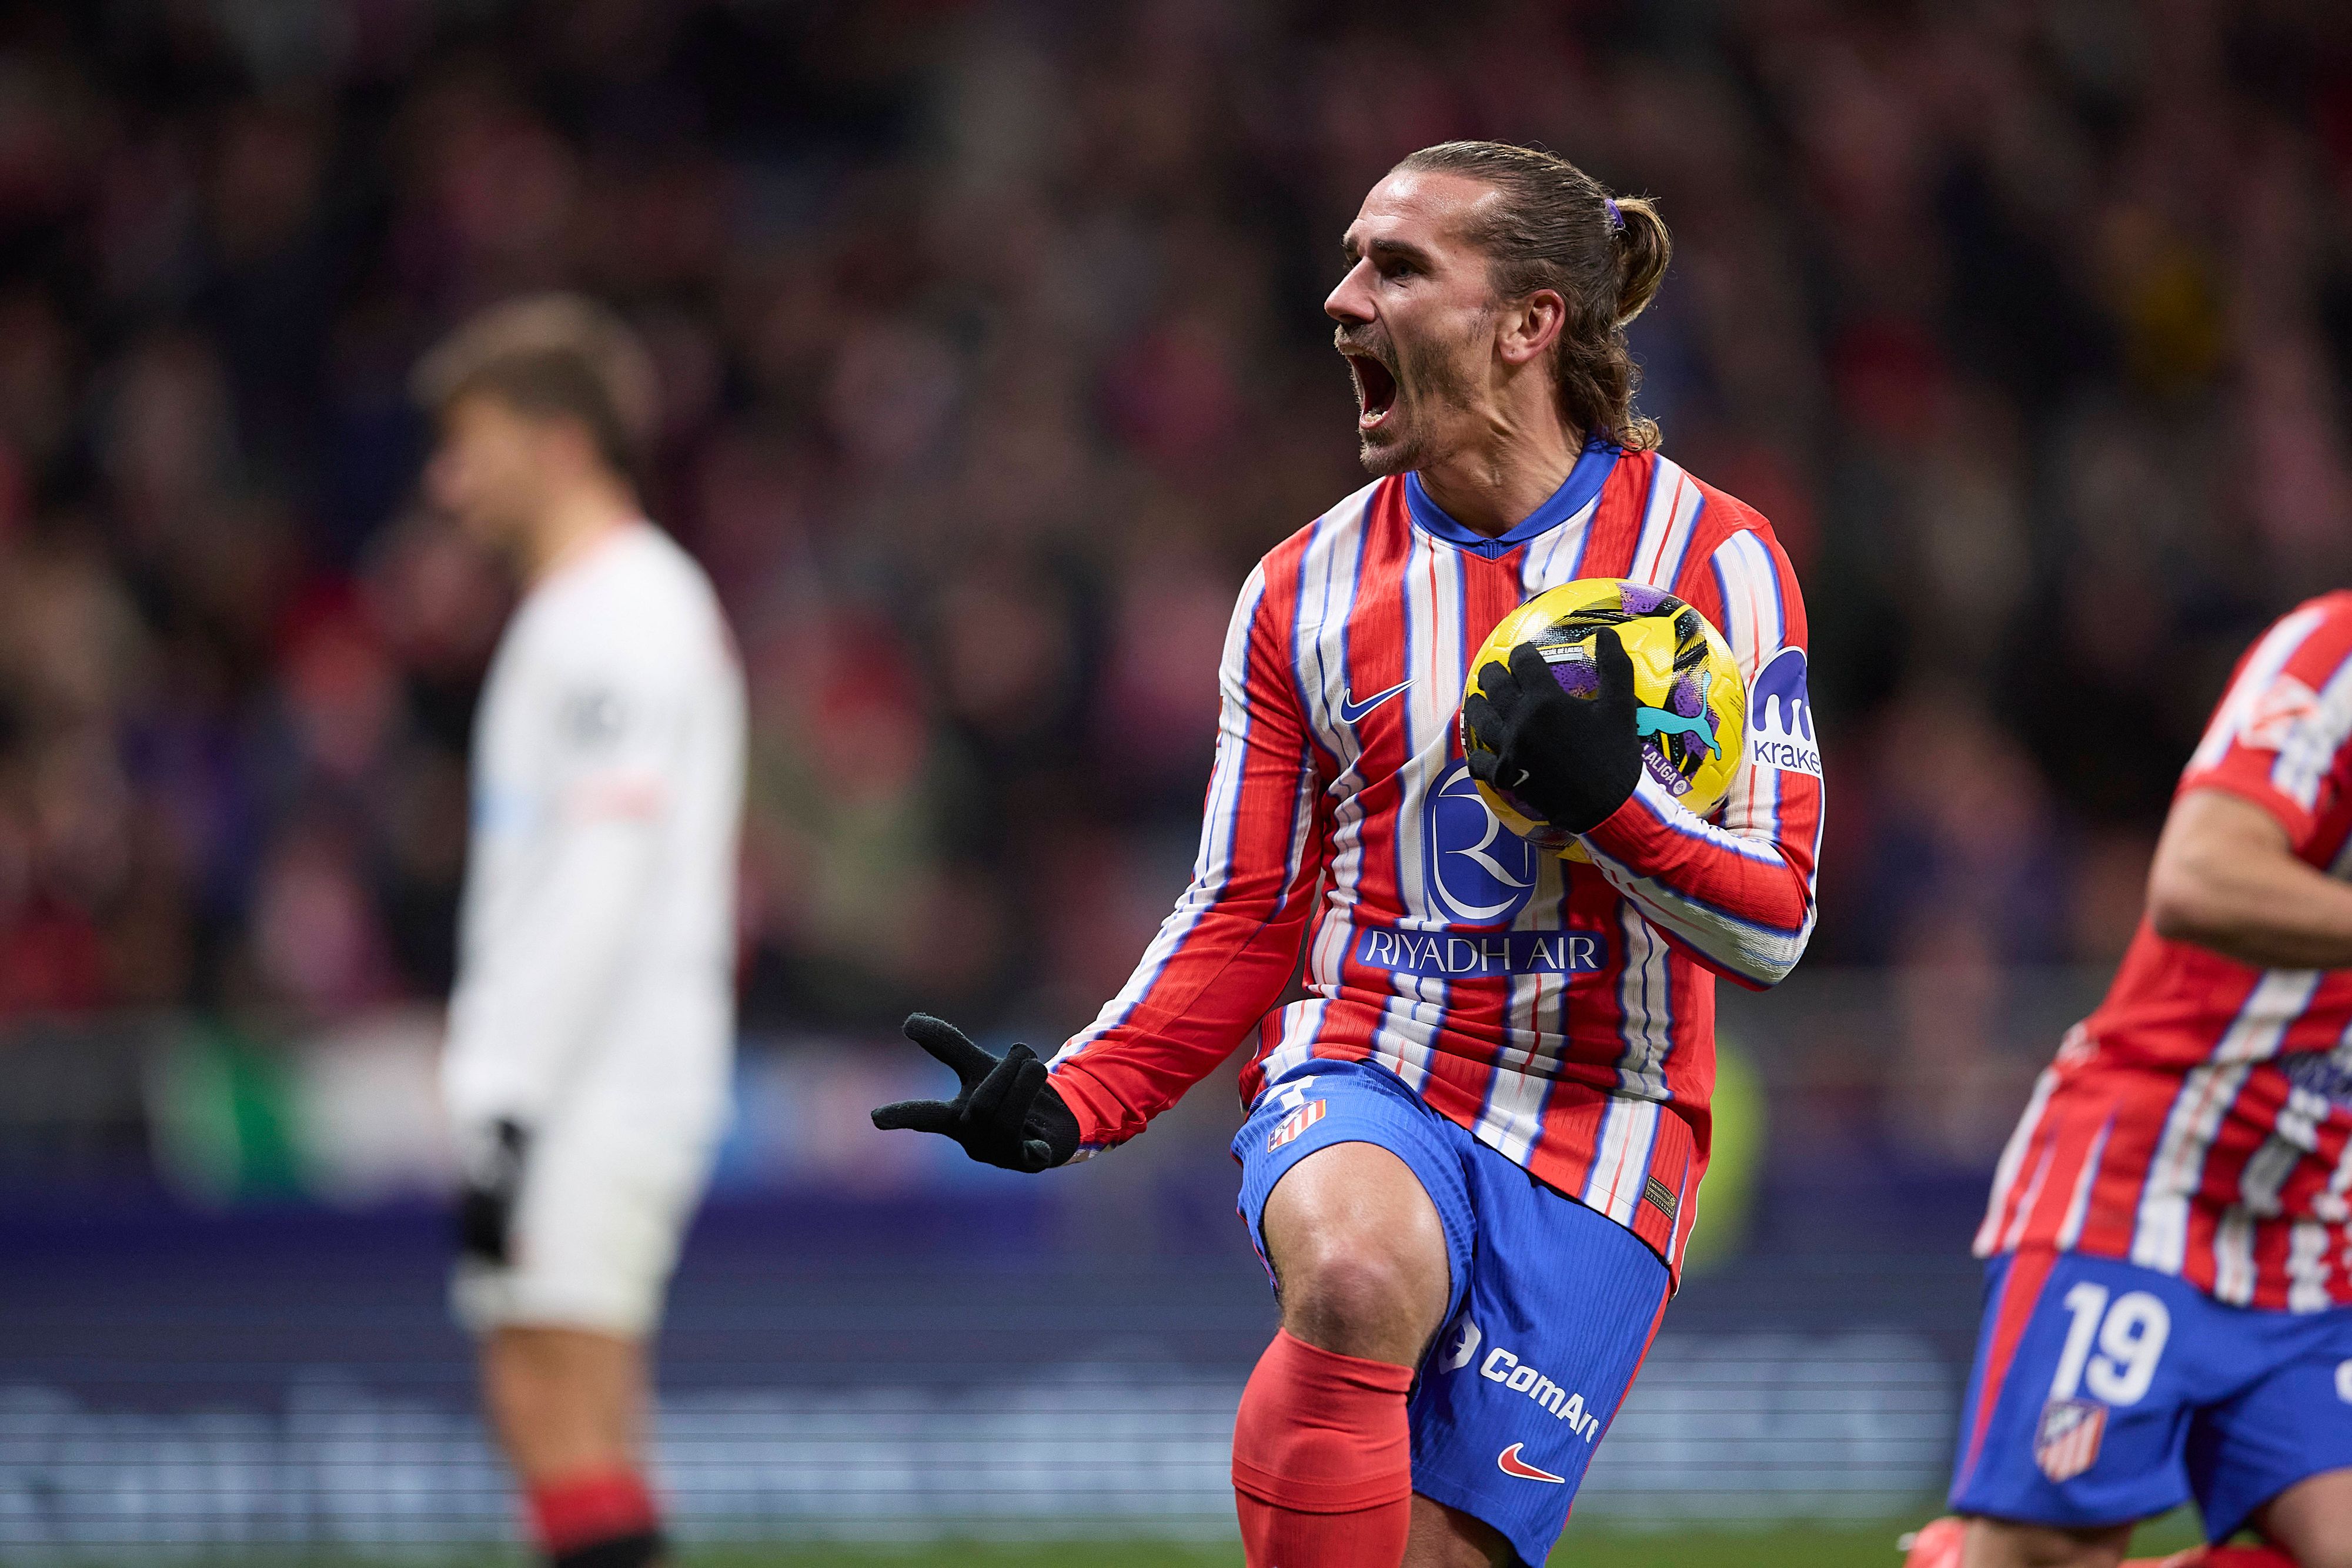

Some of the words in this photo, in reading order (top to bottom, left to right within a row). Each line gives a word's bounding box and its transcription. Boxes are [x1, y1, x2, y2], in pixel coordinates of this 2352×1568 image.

[1754, 740, 1820, 774] krake
[1365, 930, 1510, 972] RIYADH
[1526, 937, 1599, 970] AIR
[2047, 1280, 2171, 1407] 19
